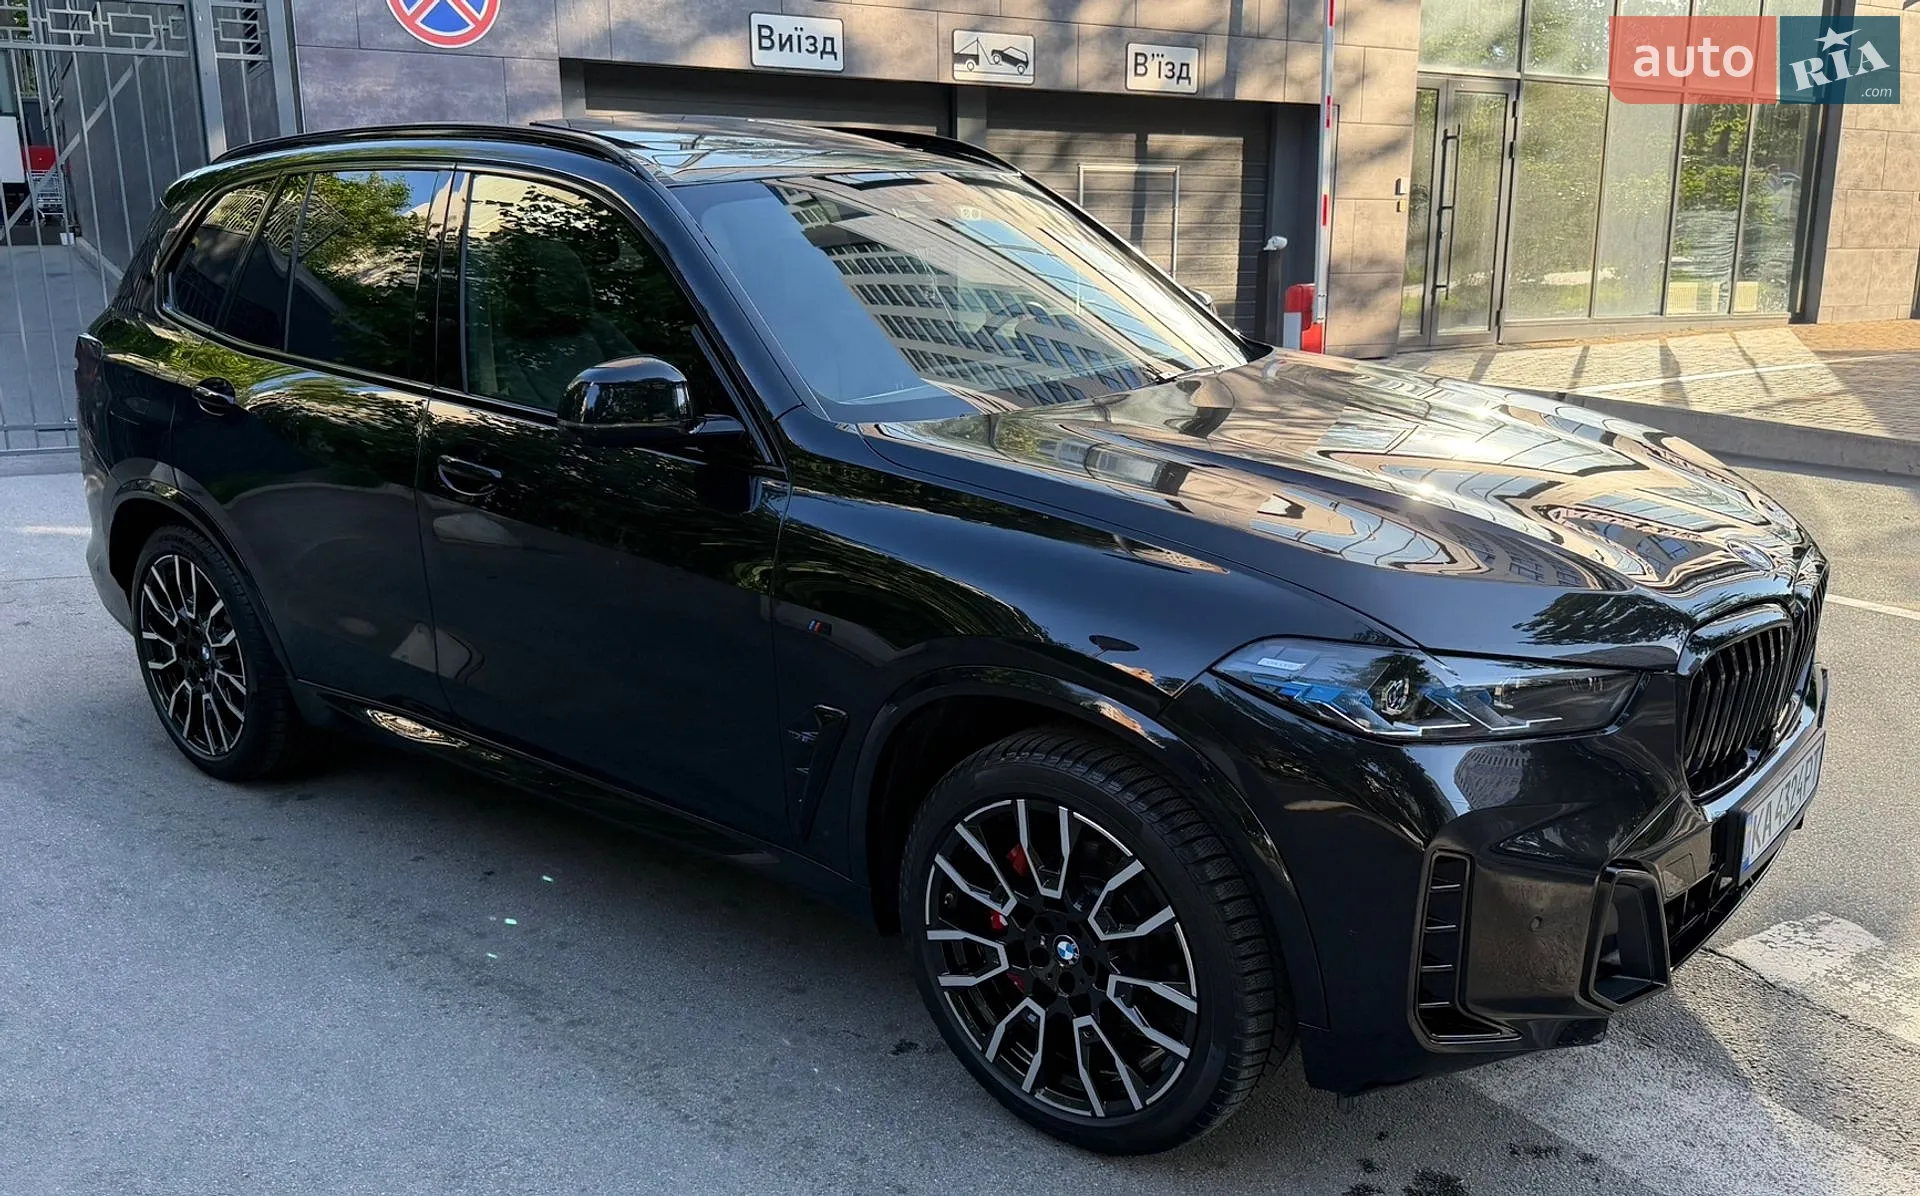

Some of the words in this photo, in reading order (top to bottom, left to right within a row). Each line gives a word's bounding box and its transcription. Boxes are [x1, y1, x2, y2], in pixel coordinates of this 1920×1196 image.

[757, 24, 838, 61] Виїзд
[1134, 51, 1192, 87] В'їзд
[1774, 763, 1805, 827] 4324
[1803, 745, 1822, 797] PT
